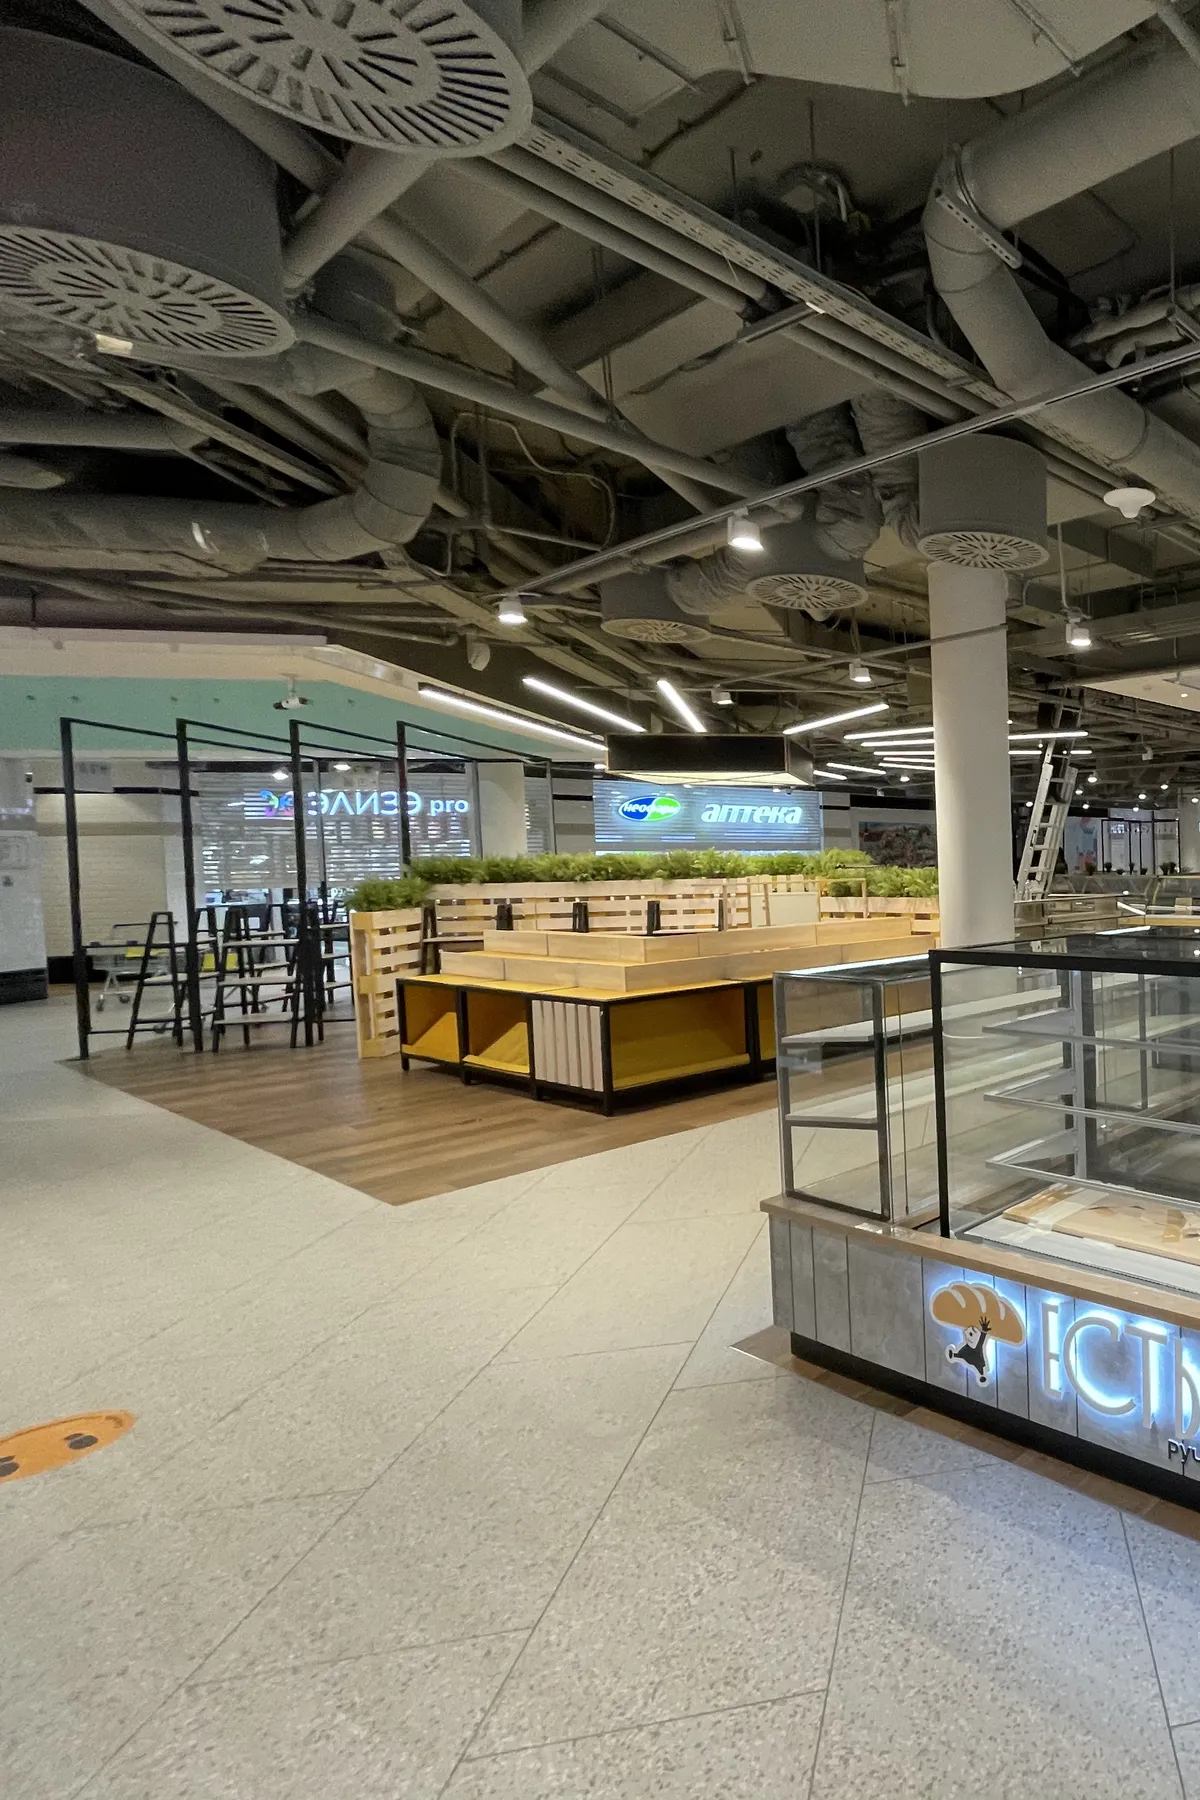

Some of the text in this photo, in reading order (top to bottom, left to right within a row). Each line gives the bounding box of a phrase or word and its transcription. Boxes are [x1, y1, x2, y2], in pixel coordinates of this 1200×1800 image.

[430, 799, 470, 816] pro
[701, 803, 803, 824] аптека
[1041, 1302, 1200, 1440] ЕСТЬ
